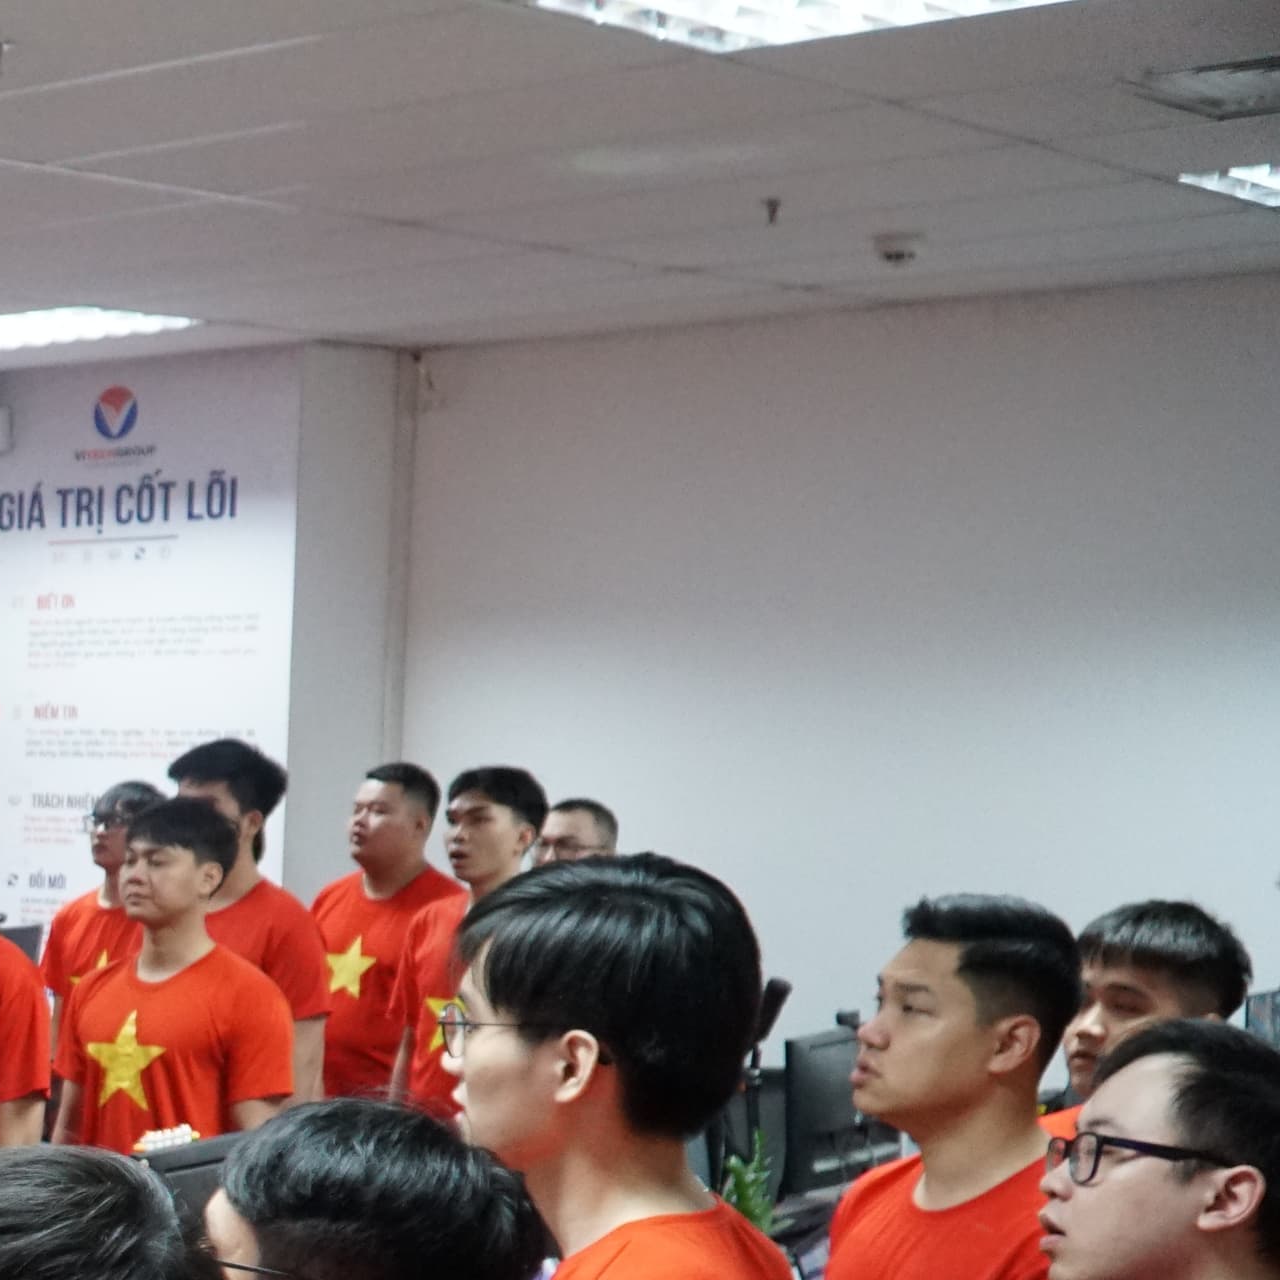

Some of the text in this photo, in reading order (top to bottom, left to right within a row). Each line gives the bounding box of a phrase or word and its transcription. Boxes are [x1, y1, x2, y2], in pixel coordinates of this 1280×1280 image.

[56, 485, 105, 534] TRỊ
[115, 469, 177, 525] CỐT
[186, 470, 238, 521] LÕI
